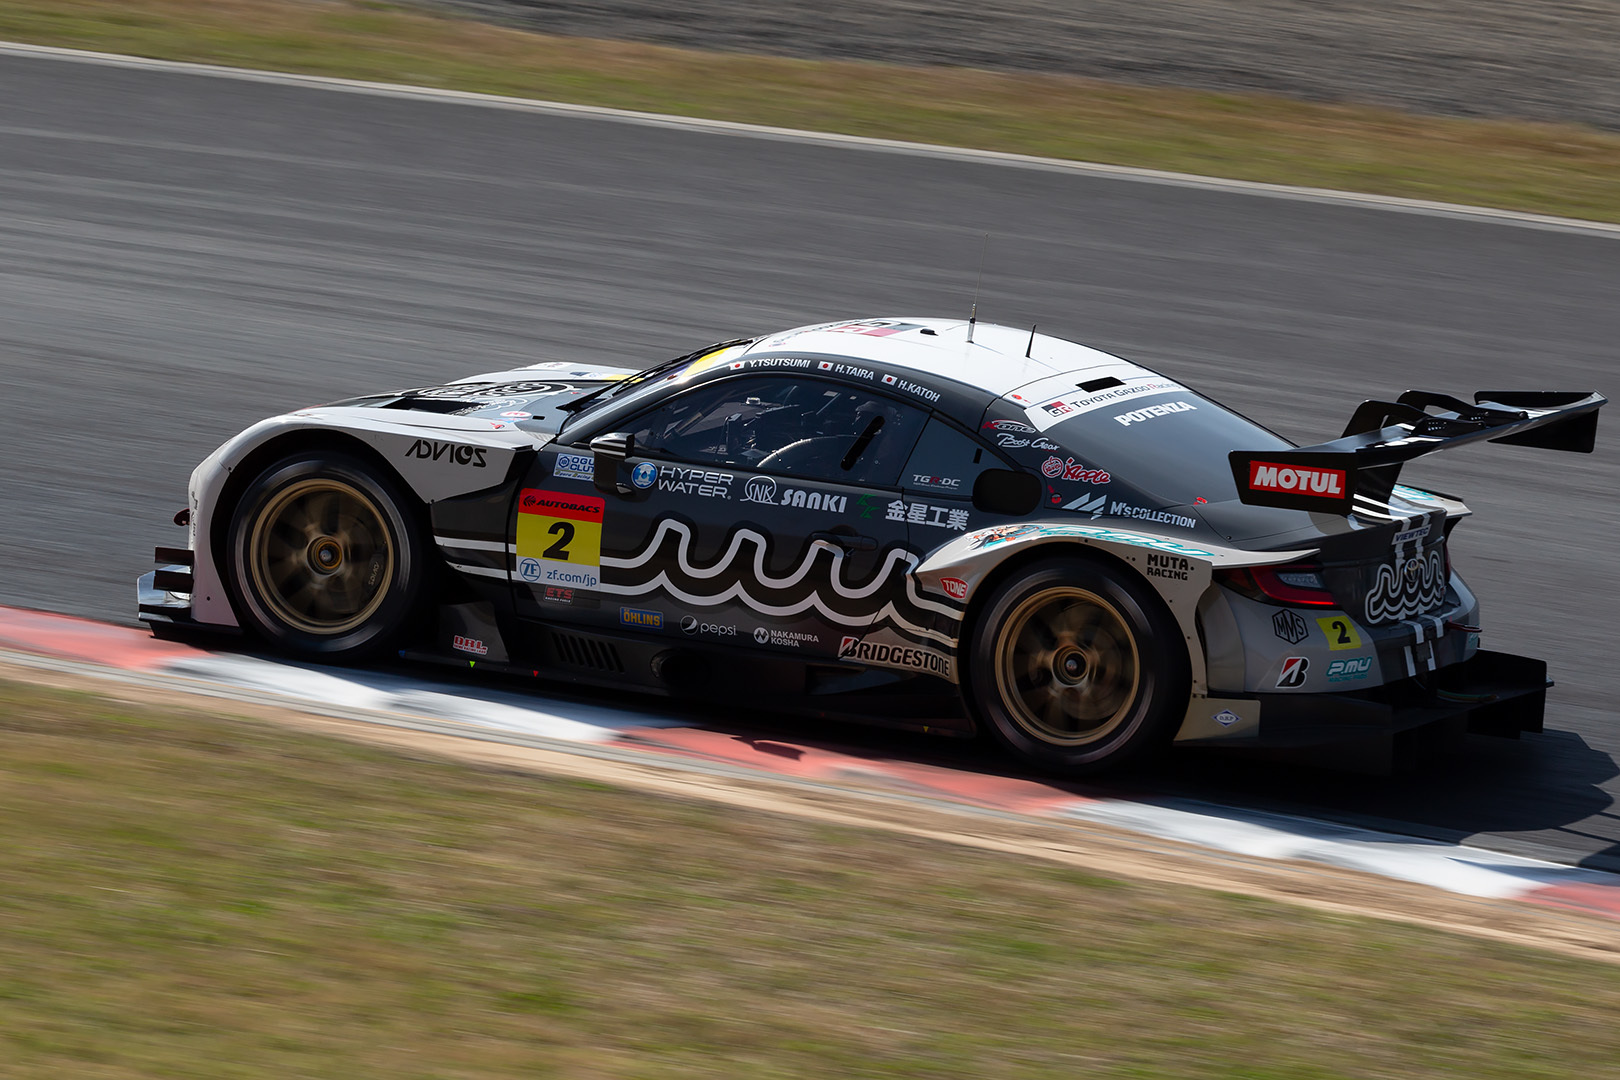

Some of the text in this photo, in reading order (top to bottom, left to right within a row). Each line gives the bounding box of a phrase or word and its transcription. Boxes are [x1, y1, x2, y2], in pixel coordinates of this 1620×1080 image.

[750, 358, 811, 368] Y.TSUTSUMI
[834, 364, 874, 381] H.TAIRA
[897, 380, 940, 402] H.KATOH
[1113, 400, 1198, 427] POTENZA
[569, 463, 594, 473] CLUT
[571, 456, 594, 466] OGU
[659, 466, 734, 485] HYPER
[1253, 466, 1341, 494] MOTUL
[658, 479, 728, 499] WATER
[749, 483, 773, 503] SNK
[536, 498, 600, 513] AUTOBACS
[780, 489, 848, 513] SANKI
[885, 500, 970, 531] 金星工業
[542, 521, 575, 561] 2
[1395, 526, 1429, 542] VIEWTEC
[1147, 554, 1189, 571] MUTA
[522, 562, 597, 587] ZF zf.com/jp
[1147, 567, 1188, 581] RACING
[546, 587, 573, 600] ETS
[943, 579, 966, 597] TONE
[623, 608, 661, 626] ÖHLINS
[700, 621, 737, 637] pepsi
[771, 629, 819, 643] NAKAMURA
[1331, 620, 1351, 644] 2
[454, 636, 487, 651] DRL
[771, 637, 800, 648] KOSHA
[838, 636, 950, 677] BRIDGESTONE
